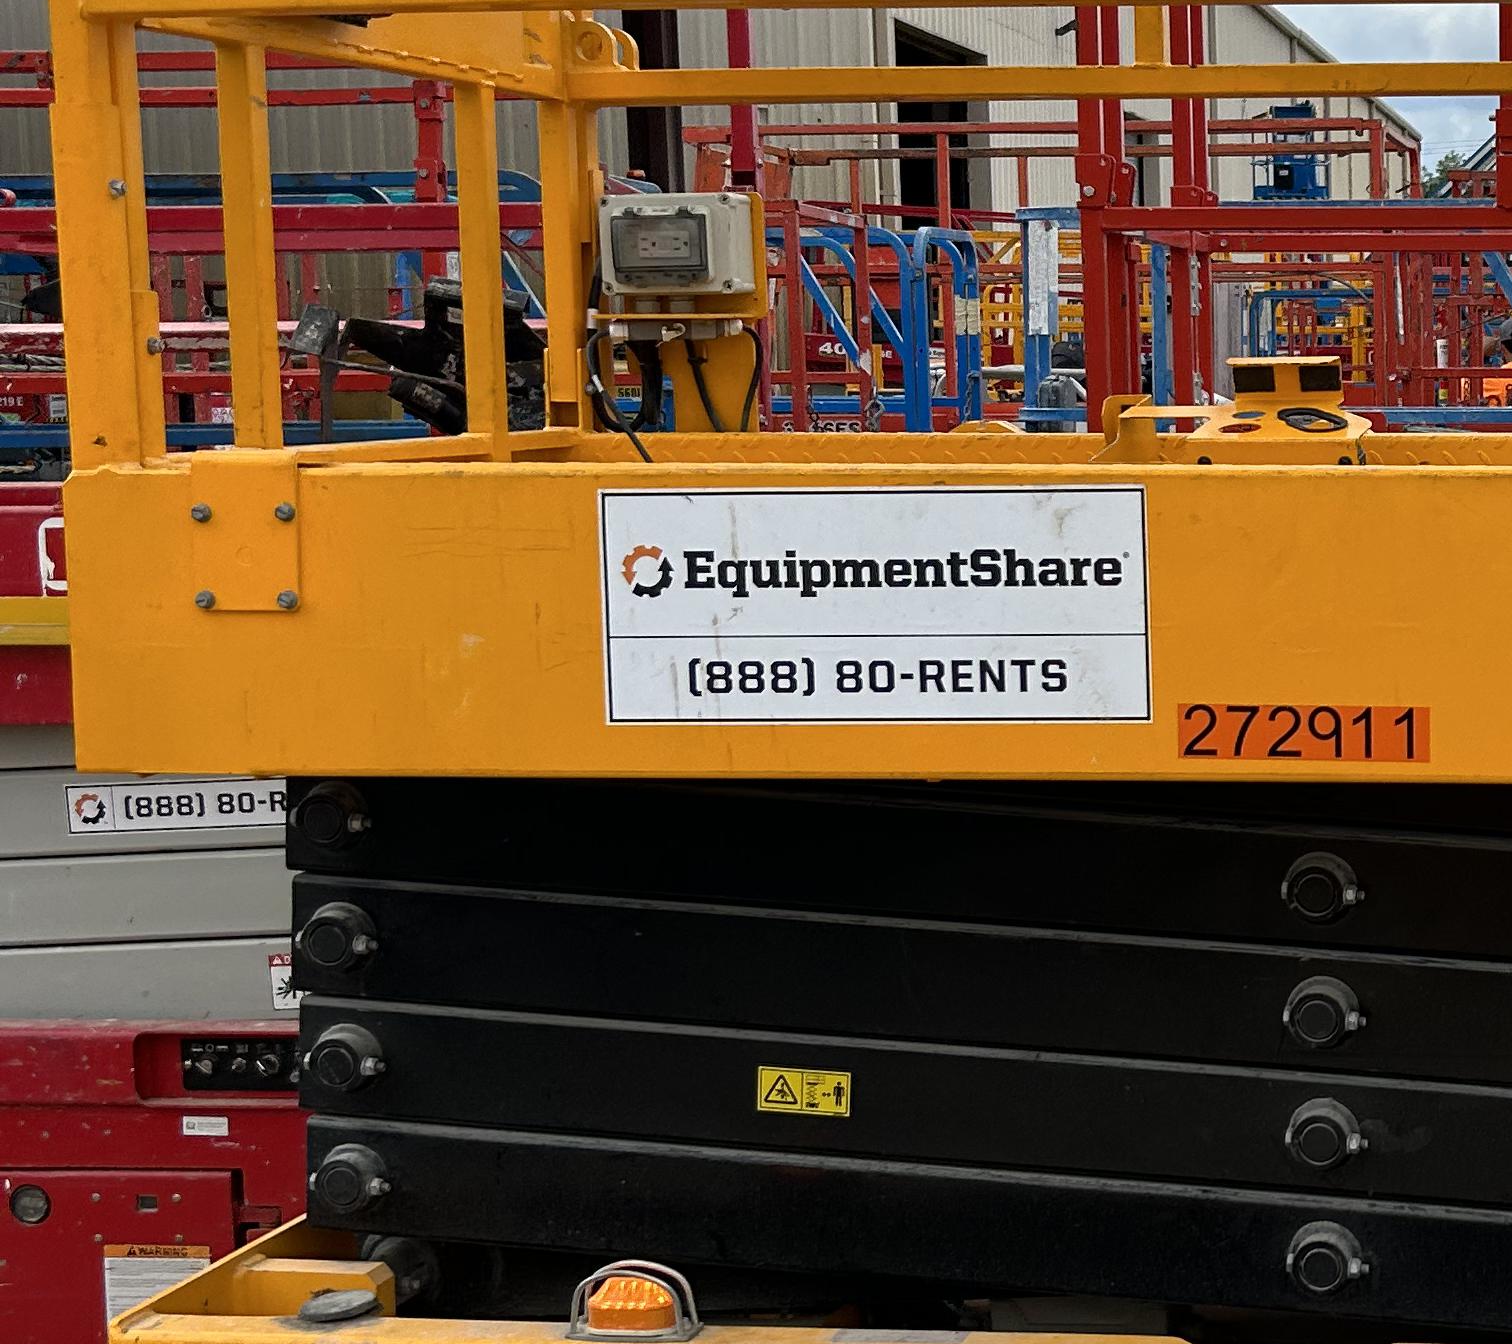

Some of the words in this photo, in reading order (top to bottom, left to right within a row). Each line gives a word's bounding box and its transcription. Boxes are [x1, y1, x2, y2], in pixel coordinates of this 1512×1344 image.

[684, 549, 1125, 597] EquipmentShare
[688, 658, 815, 697] (888)
[835, 658, 1068, 694] 80-RENTS
[1184, 703, 1422, 760] 272911
[124, 793, 205, 819] (888)
[139, 1246, 188, 1256] WARNING
